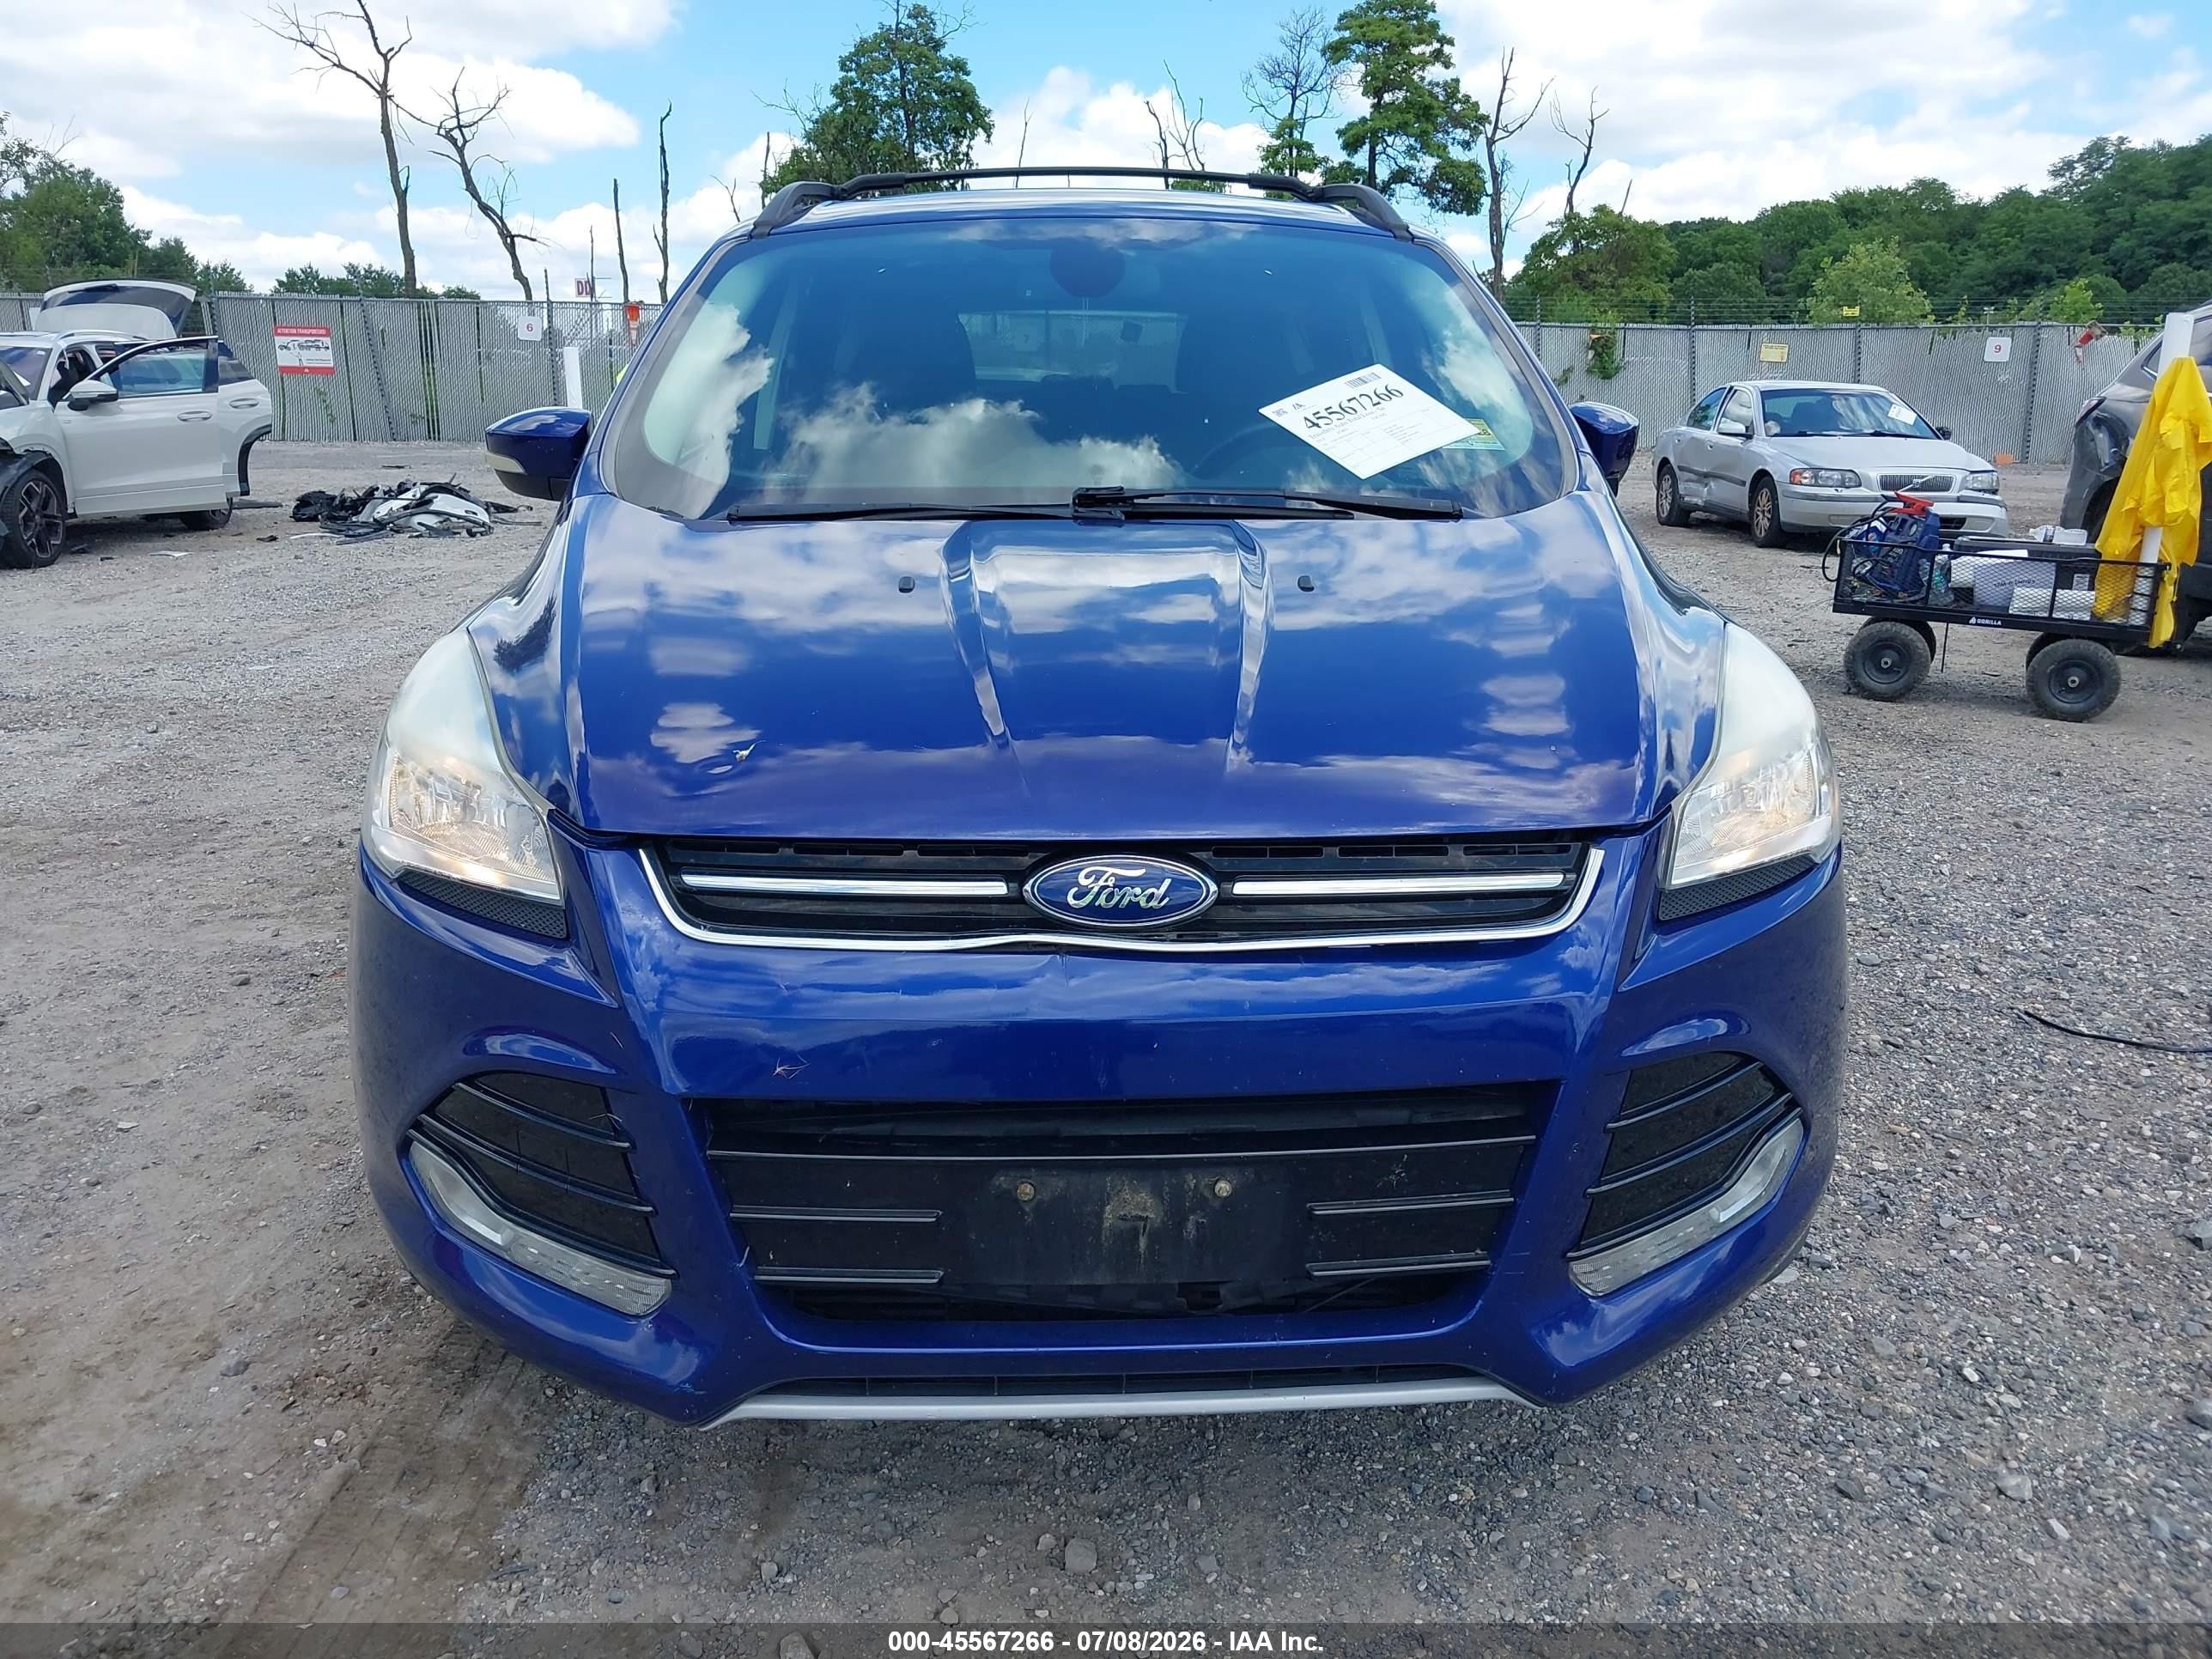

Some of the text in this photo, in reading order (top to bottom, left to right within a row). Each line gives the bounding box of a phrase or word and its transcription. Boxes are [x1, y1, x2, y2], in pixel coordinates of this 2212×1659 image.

[526, 323, 534, 331] 6
[1994, 343, 2002, 354] 9
[1303, 384, 1404, 429] 45567266
[1066, 866, 1173, 909] Ford
